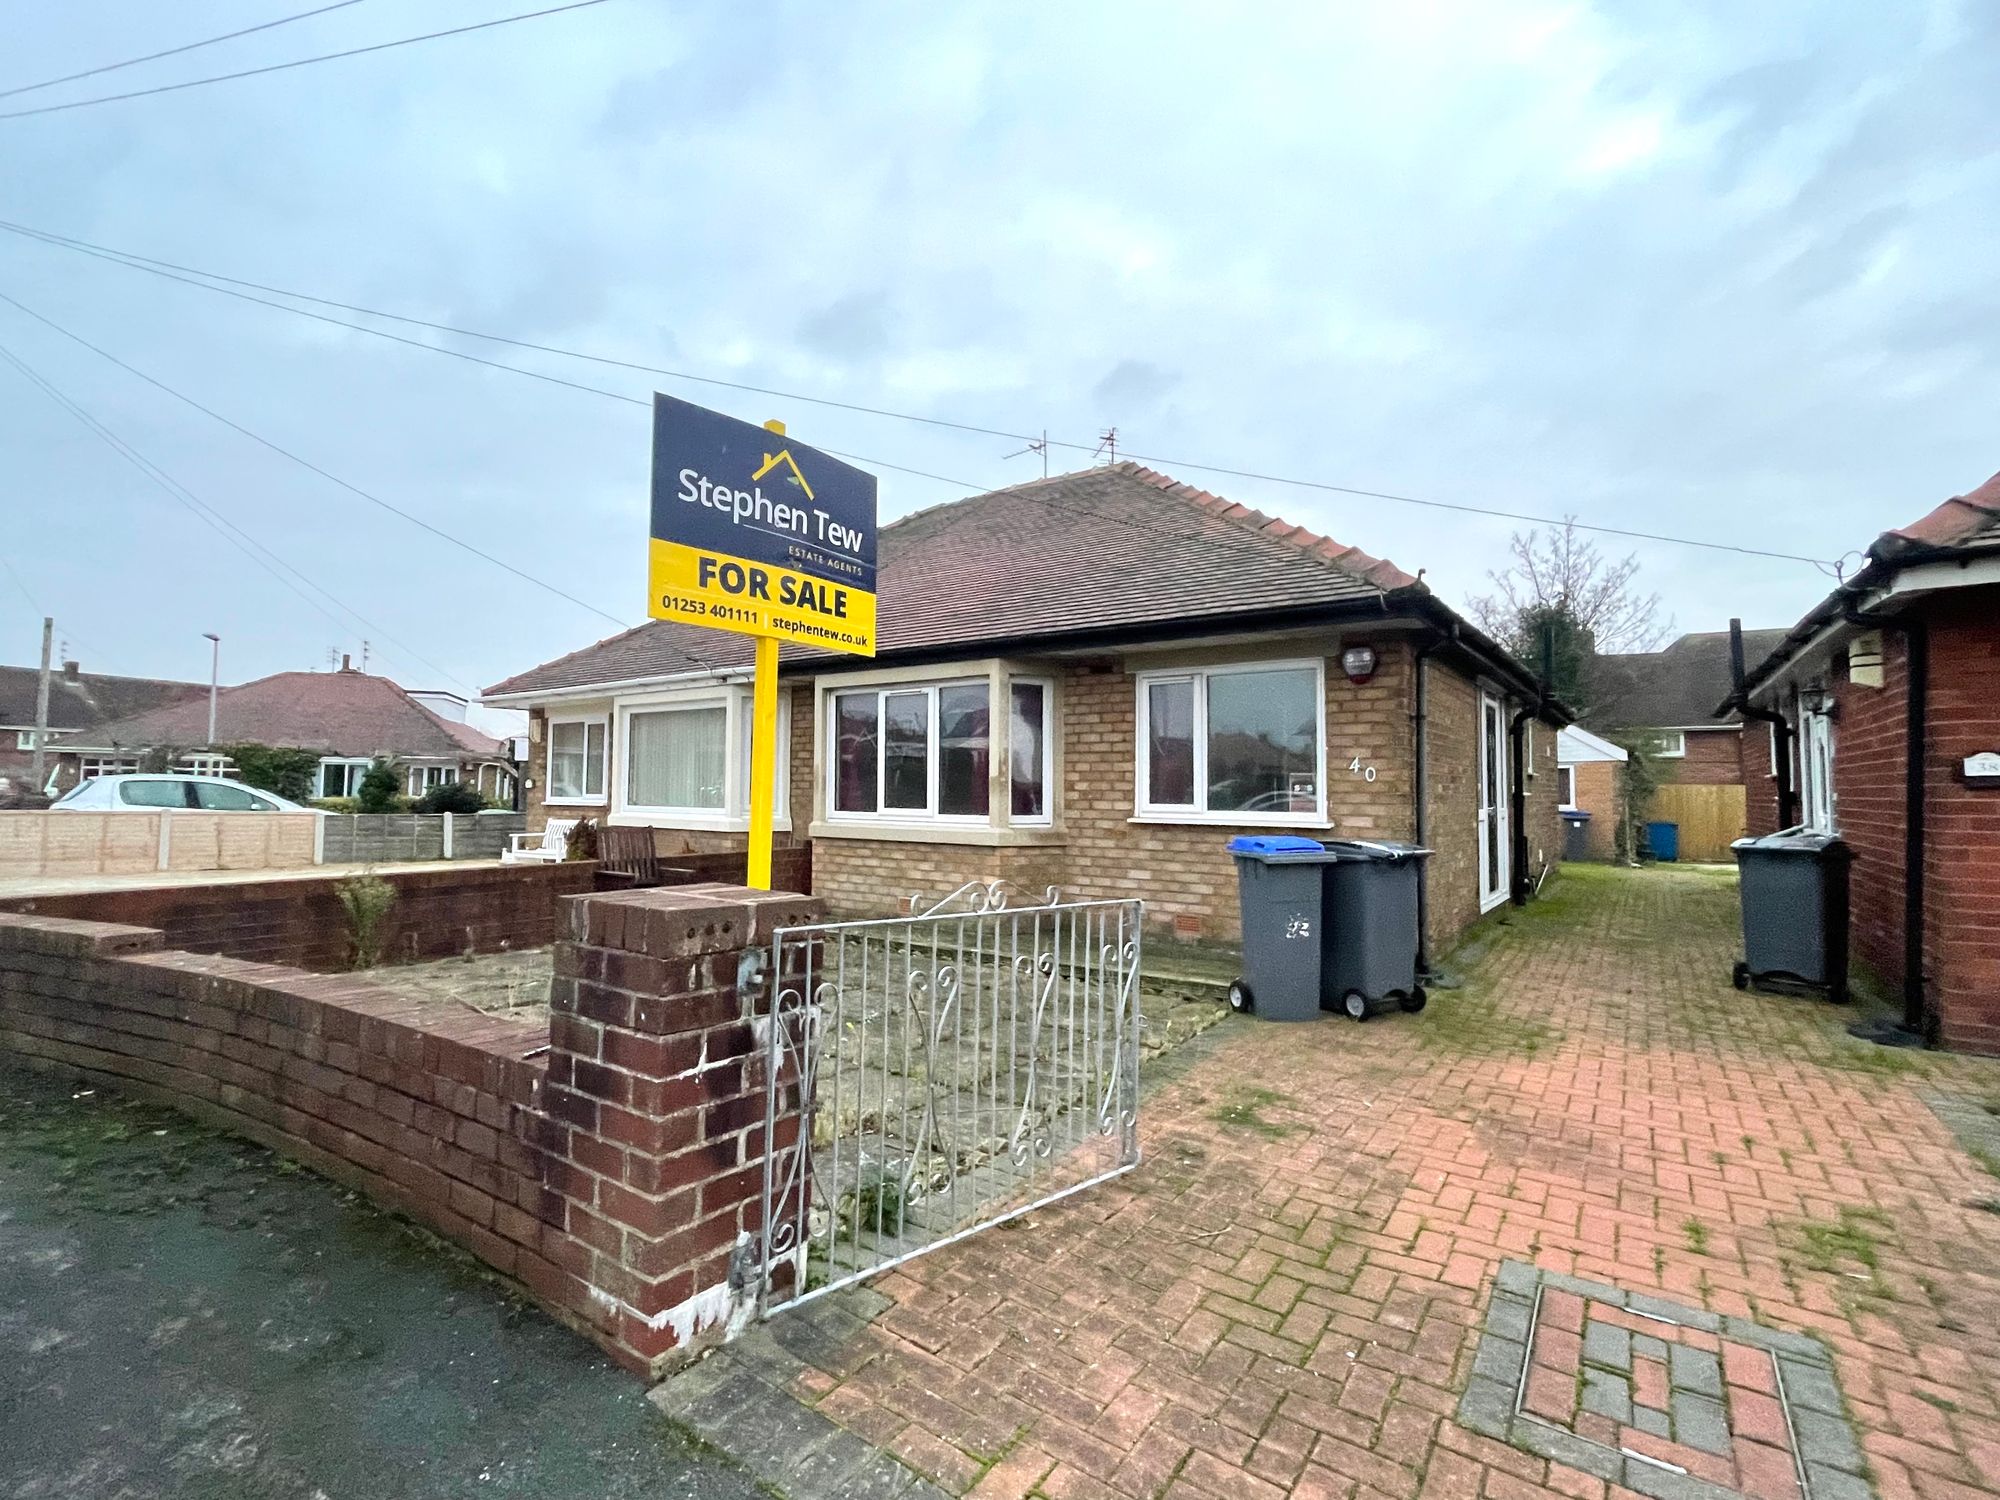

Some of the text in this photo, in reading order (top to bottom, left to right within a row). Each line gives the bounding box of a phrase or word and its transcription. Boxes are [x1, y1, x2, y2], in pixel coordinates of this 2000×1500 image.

[678, 468, 863, 553] Stephen Tew
[789, 545, 863, 576] ESTATE AGENTS
[698, 556, 847, 619] FOR SALE
[662, 595, 868, 648] 01253 401111 stephentew.co.uk
[1348, 756, 1376, 782] 40
